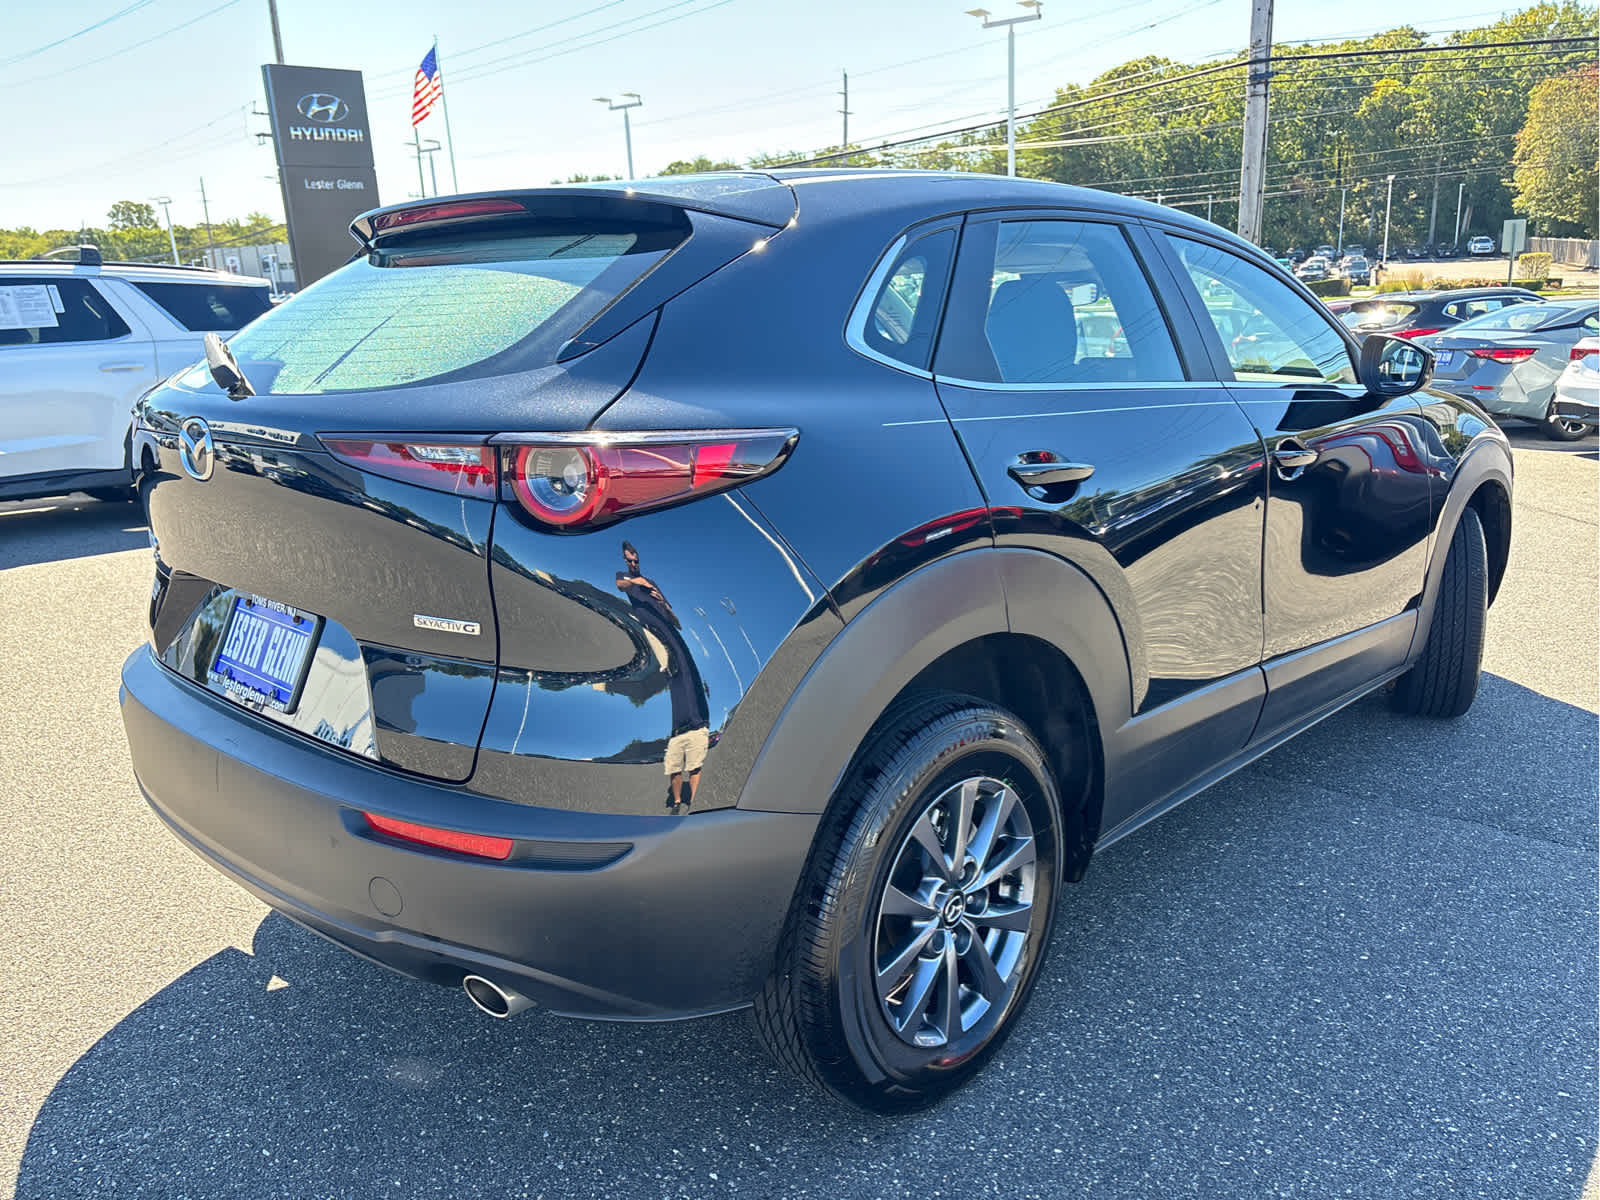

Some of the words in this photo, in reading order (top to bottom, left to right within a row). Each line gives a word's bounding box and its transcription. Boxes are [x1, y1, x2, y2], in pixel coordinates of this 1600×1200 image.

[289, 126, 364, 142] HYUNDAI
[304, 178, 334, 190] Lester
[337, 180, 364, 190] Glenn
[251, 593, 268, 608] TOMS
[287, 605, 297, 617] NJ
[416, 617, 462, 631] SKYACTIV
[463, 624, 475, 633] G
[222, 610, 269, 669] LESTER
[261, 625, 309, 686] GLENN
